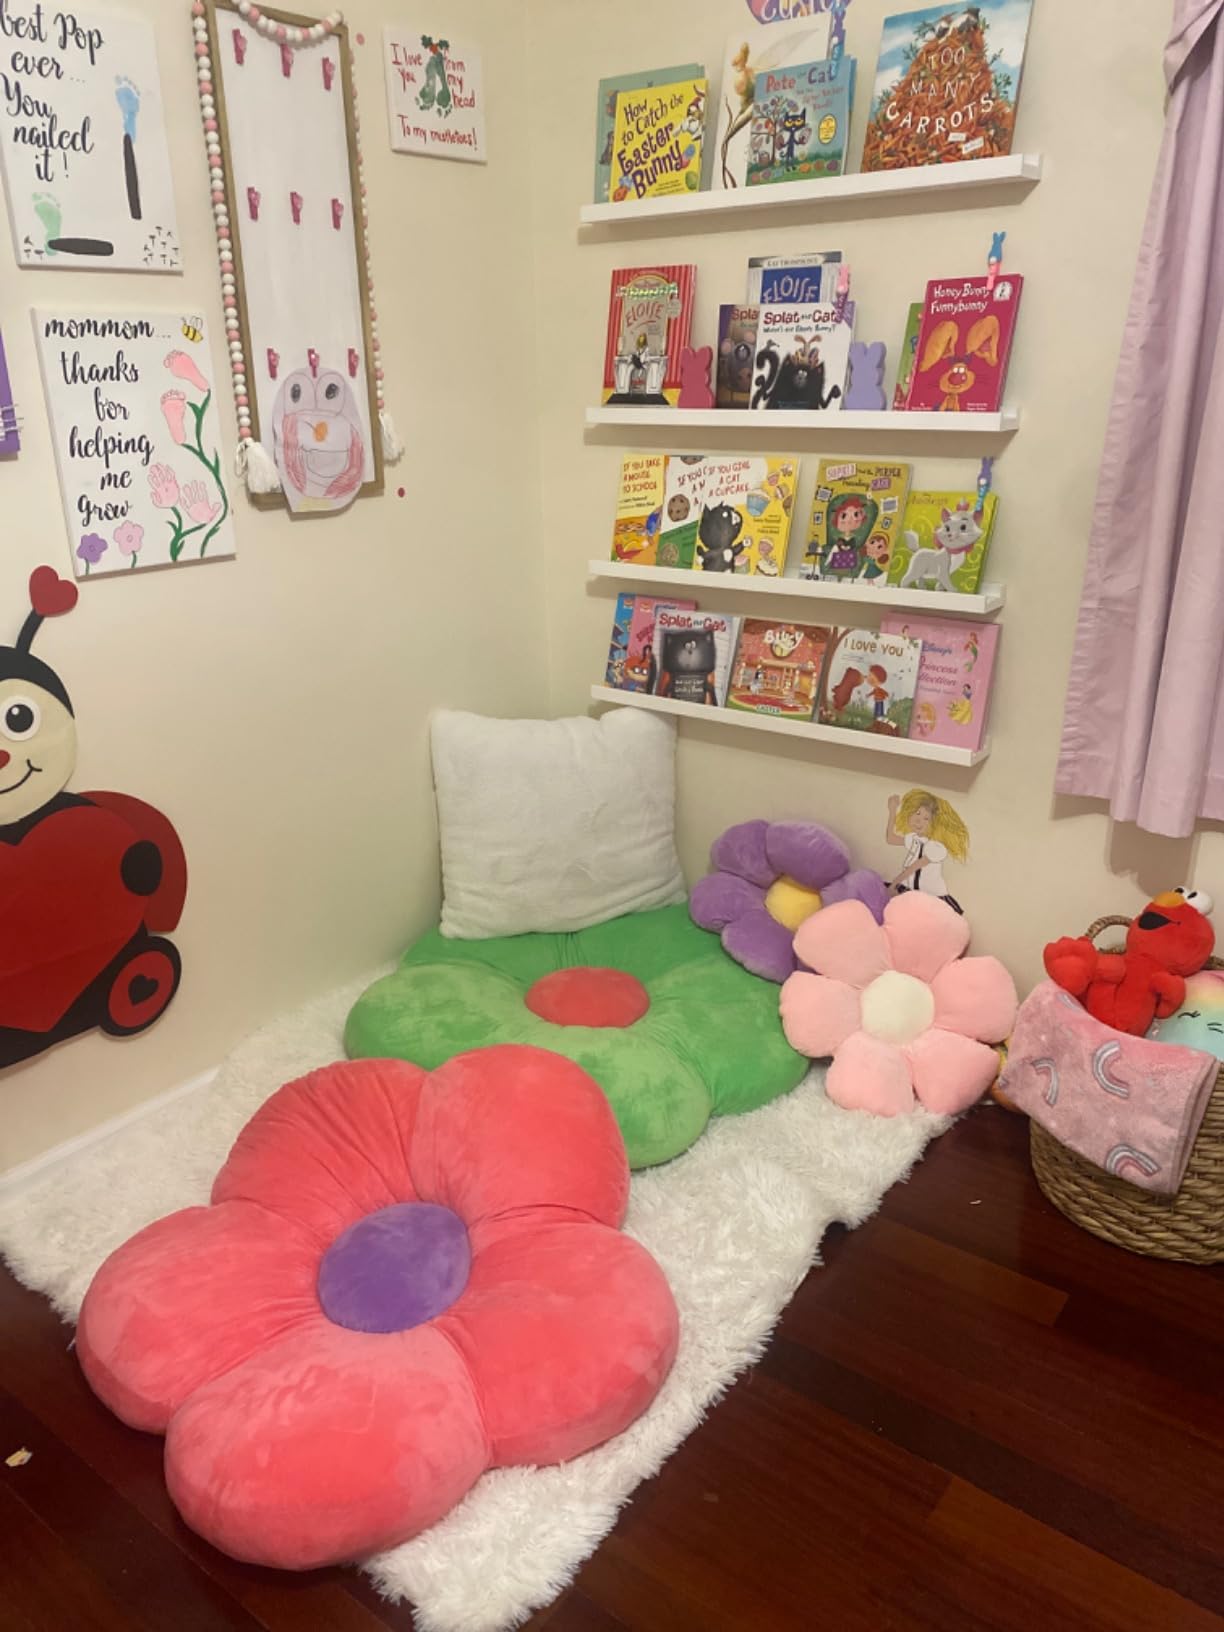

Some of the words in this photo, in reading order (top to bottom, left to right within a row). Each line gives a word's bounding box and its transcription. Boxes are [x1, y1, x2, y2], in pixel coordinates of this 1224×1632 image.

[0, 1, 47, 43] best
[54, 13, 104, 66] Pop
[390, 43, 402, 65] I
[403, 47, 422, 66] love
[443, 48, 466, 72] from
[928, 47, 965, 70] TOO
[398, 67, 416, 93] you
[447, 74, 463, 94] my
[766, 75, 796, 94] Pete
[911, 71, 981, 100] MANY
[1, 73, 51, 118] You
[451, 88, 476, 108] head
[622, 131, 634, 146] to
[636, 98, 668, 135] Catch
[624, 99, 647, 125] How
[887, 92, 994, 135] CARROTS
[13, 115, 94, 154] nailed
[397, 114, 411, 138] To
[413, 127, 427, 144] my
[617, 122, 674, 176] Easter
[632, 140, 683, 199] Bunny
[934, 285, 962, 300] Honey
[731, 308, 760, 322] Spla
[763, 311, 800, 325] Splat
[812, 310, 841, 325] Cat
[931, 300, 988, 315] Funnybunny
[60, 350, 139, 385] thanks
[94, 387, 130, 422] for
[69, 426, 155, 469] helping
[100, 470, 132, 490] me
[717, 464, 731, 474] YOU
[726, 473, 740, 484] CAT
[715, 483, 750, 497] CUPCAKE
[659, 613, 693, 628] Splat
[704, 617, 727, 632] Cat
[844, 638, 848, 648] I
